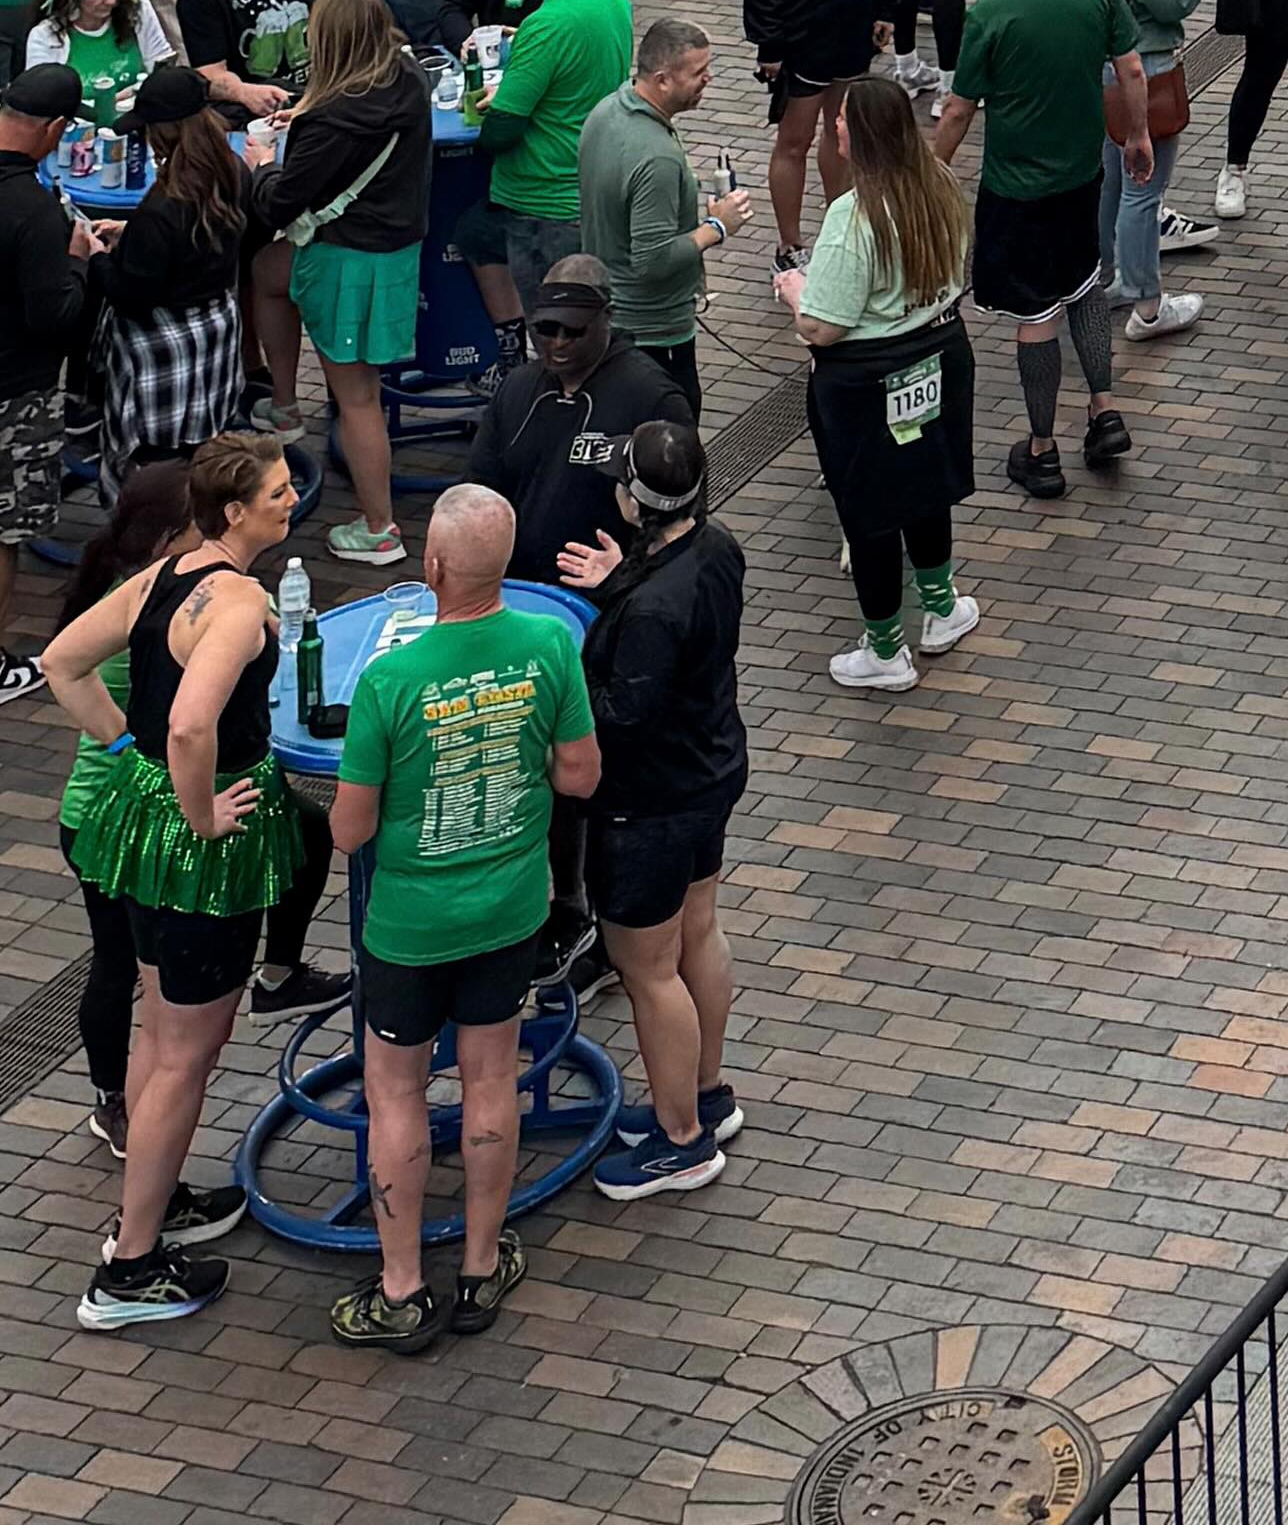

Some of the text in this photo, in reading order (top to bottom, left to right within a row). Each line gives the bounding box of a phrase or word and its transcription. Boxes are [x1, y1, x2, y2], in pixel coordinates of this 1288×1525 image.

[449, 346, 476, 358] BUD
[445, 353, 481, 366] LIGHT
[893, 380, 937, 416] 1180
